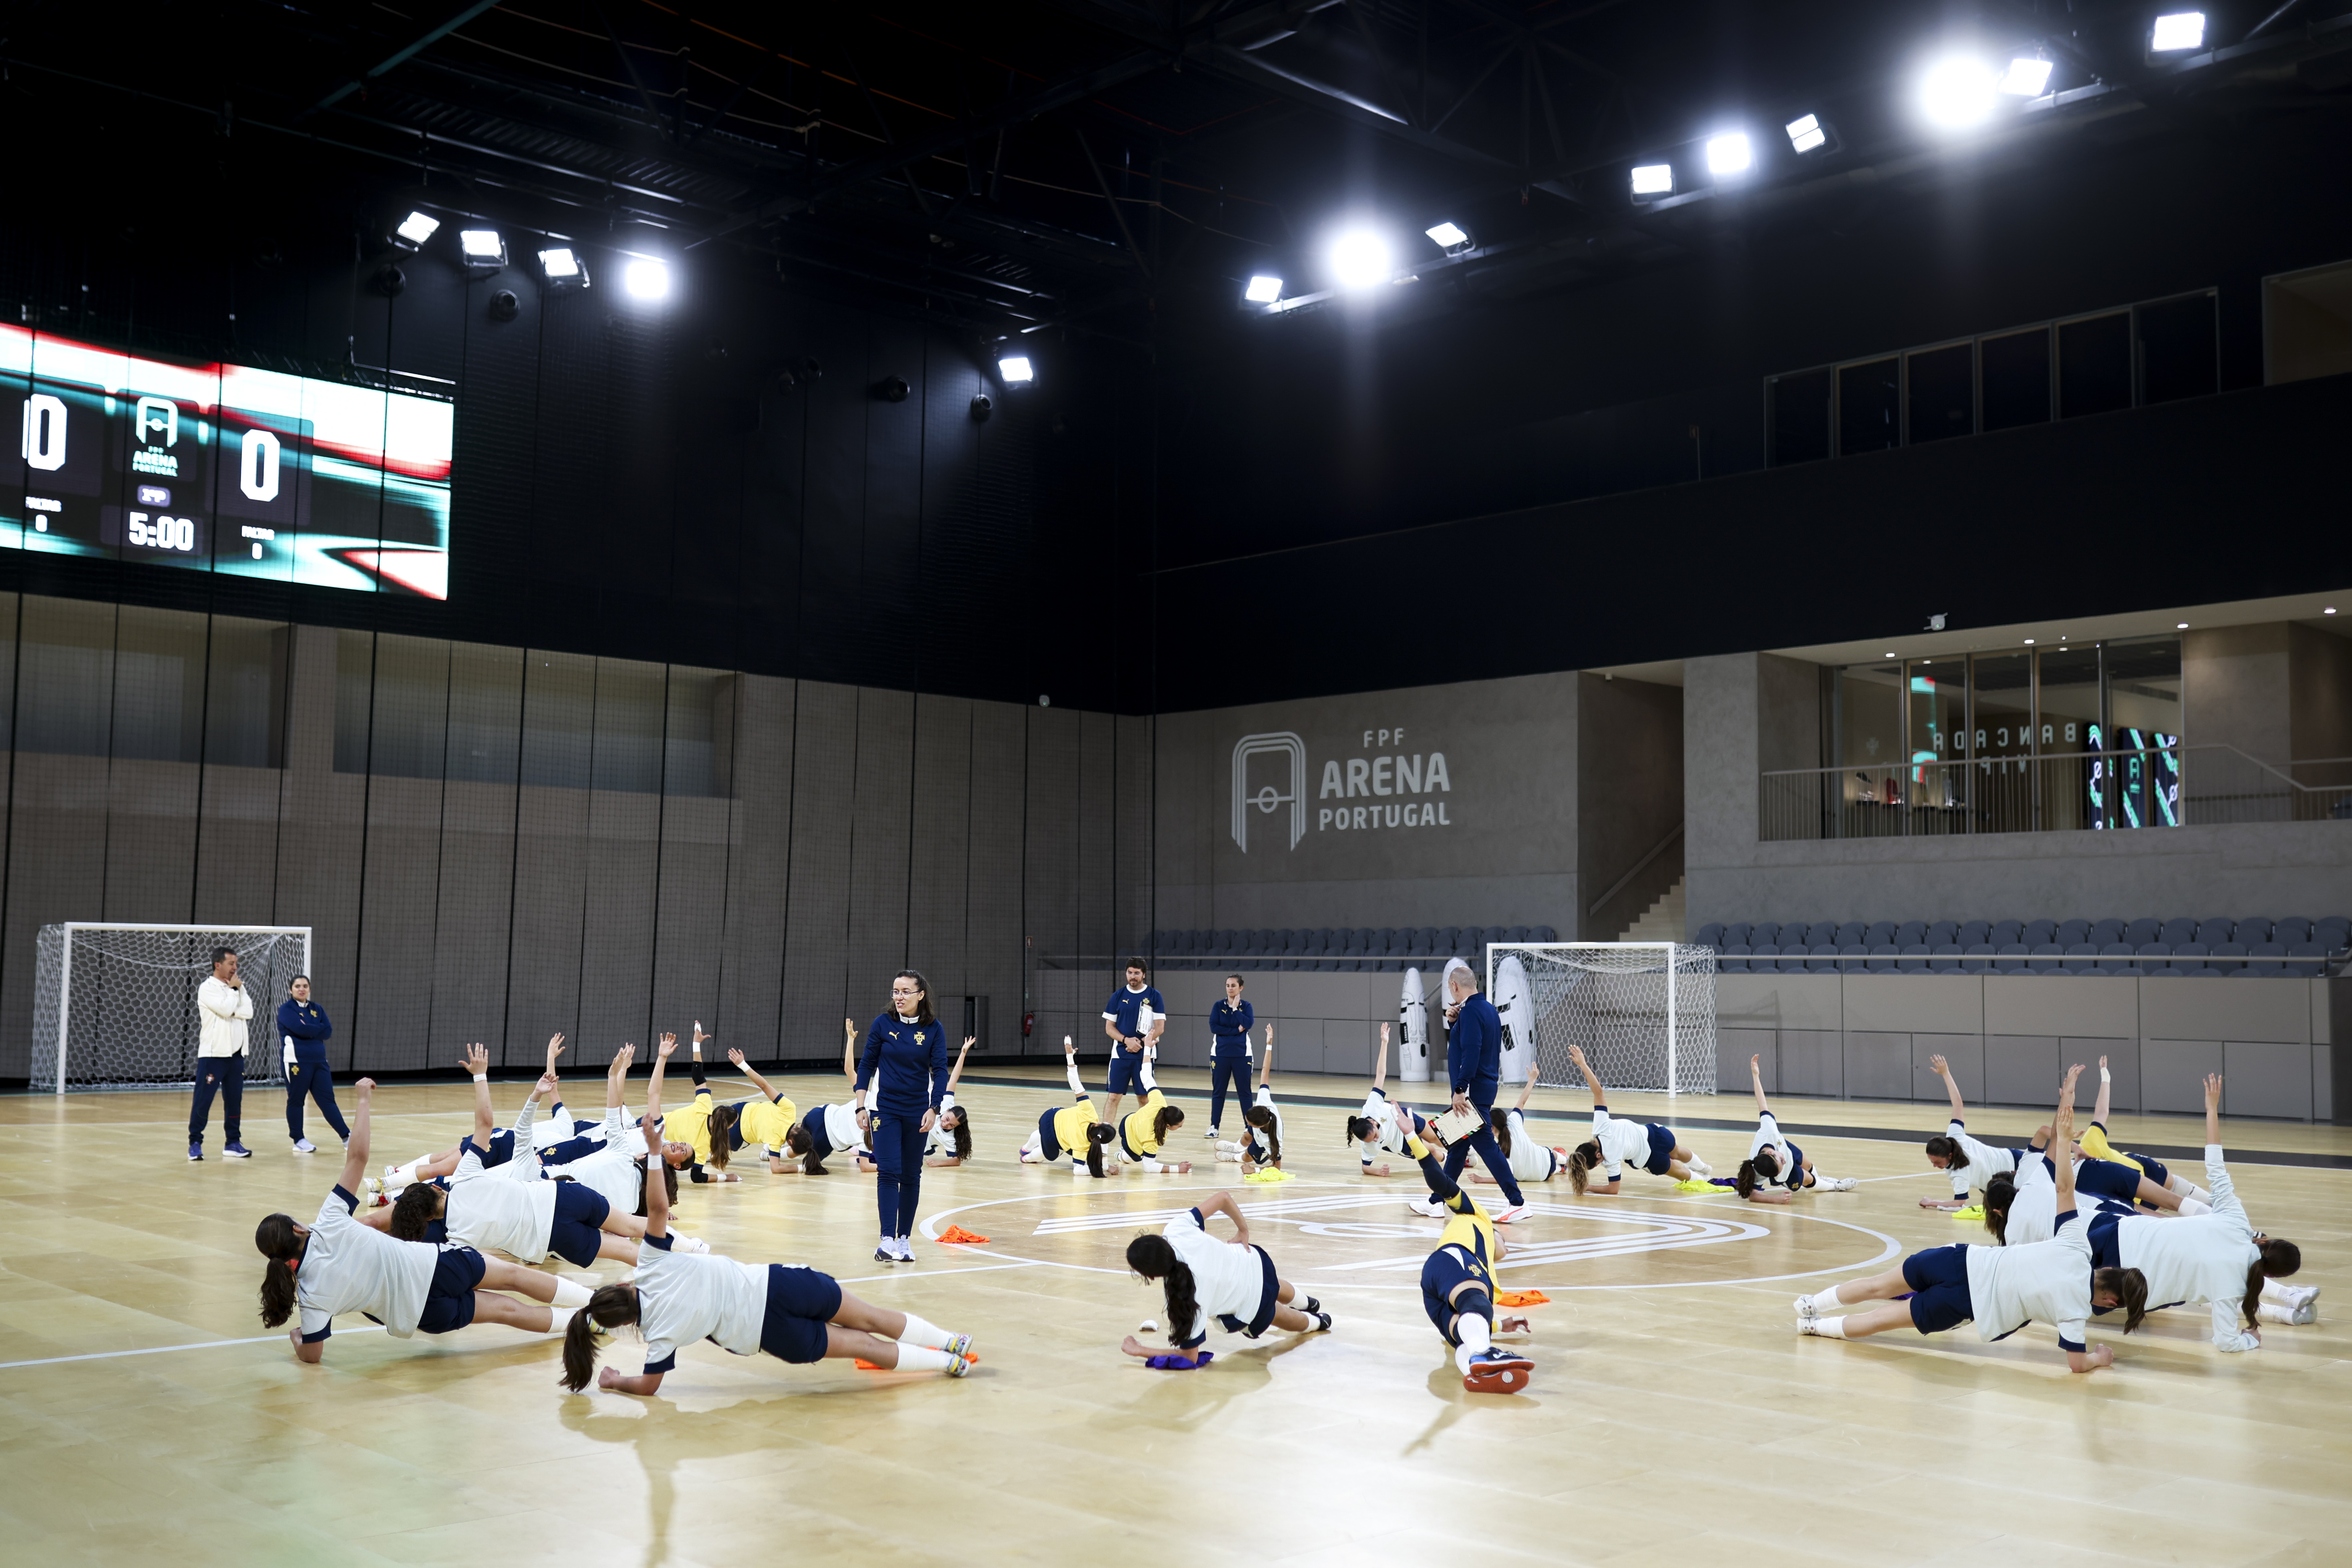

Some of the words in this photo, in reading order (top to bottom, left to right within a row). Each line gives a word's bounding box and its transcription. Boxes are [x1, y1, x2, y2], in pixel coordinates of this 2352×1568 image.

[22, 394, 67, 471] 0
[132, 462, 178, 477] PORTUGAL
[133, 451, 178, 469] ARENA
[241, 429, 280, 501] 0
[129, 512, 194, 551] 5:00
[1364, 728, 1404, 748] FPF
[1320, 752, 1450, 799] ARENA
[1319, 802, 1450, 831] PORTUGAL
